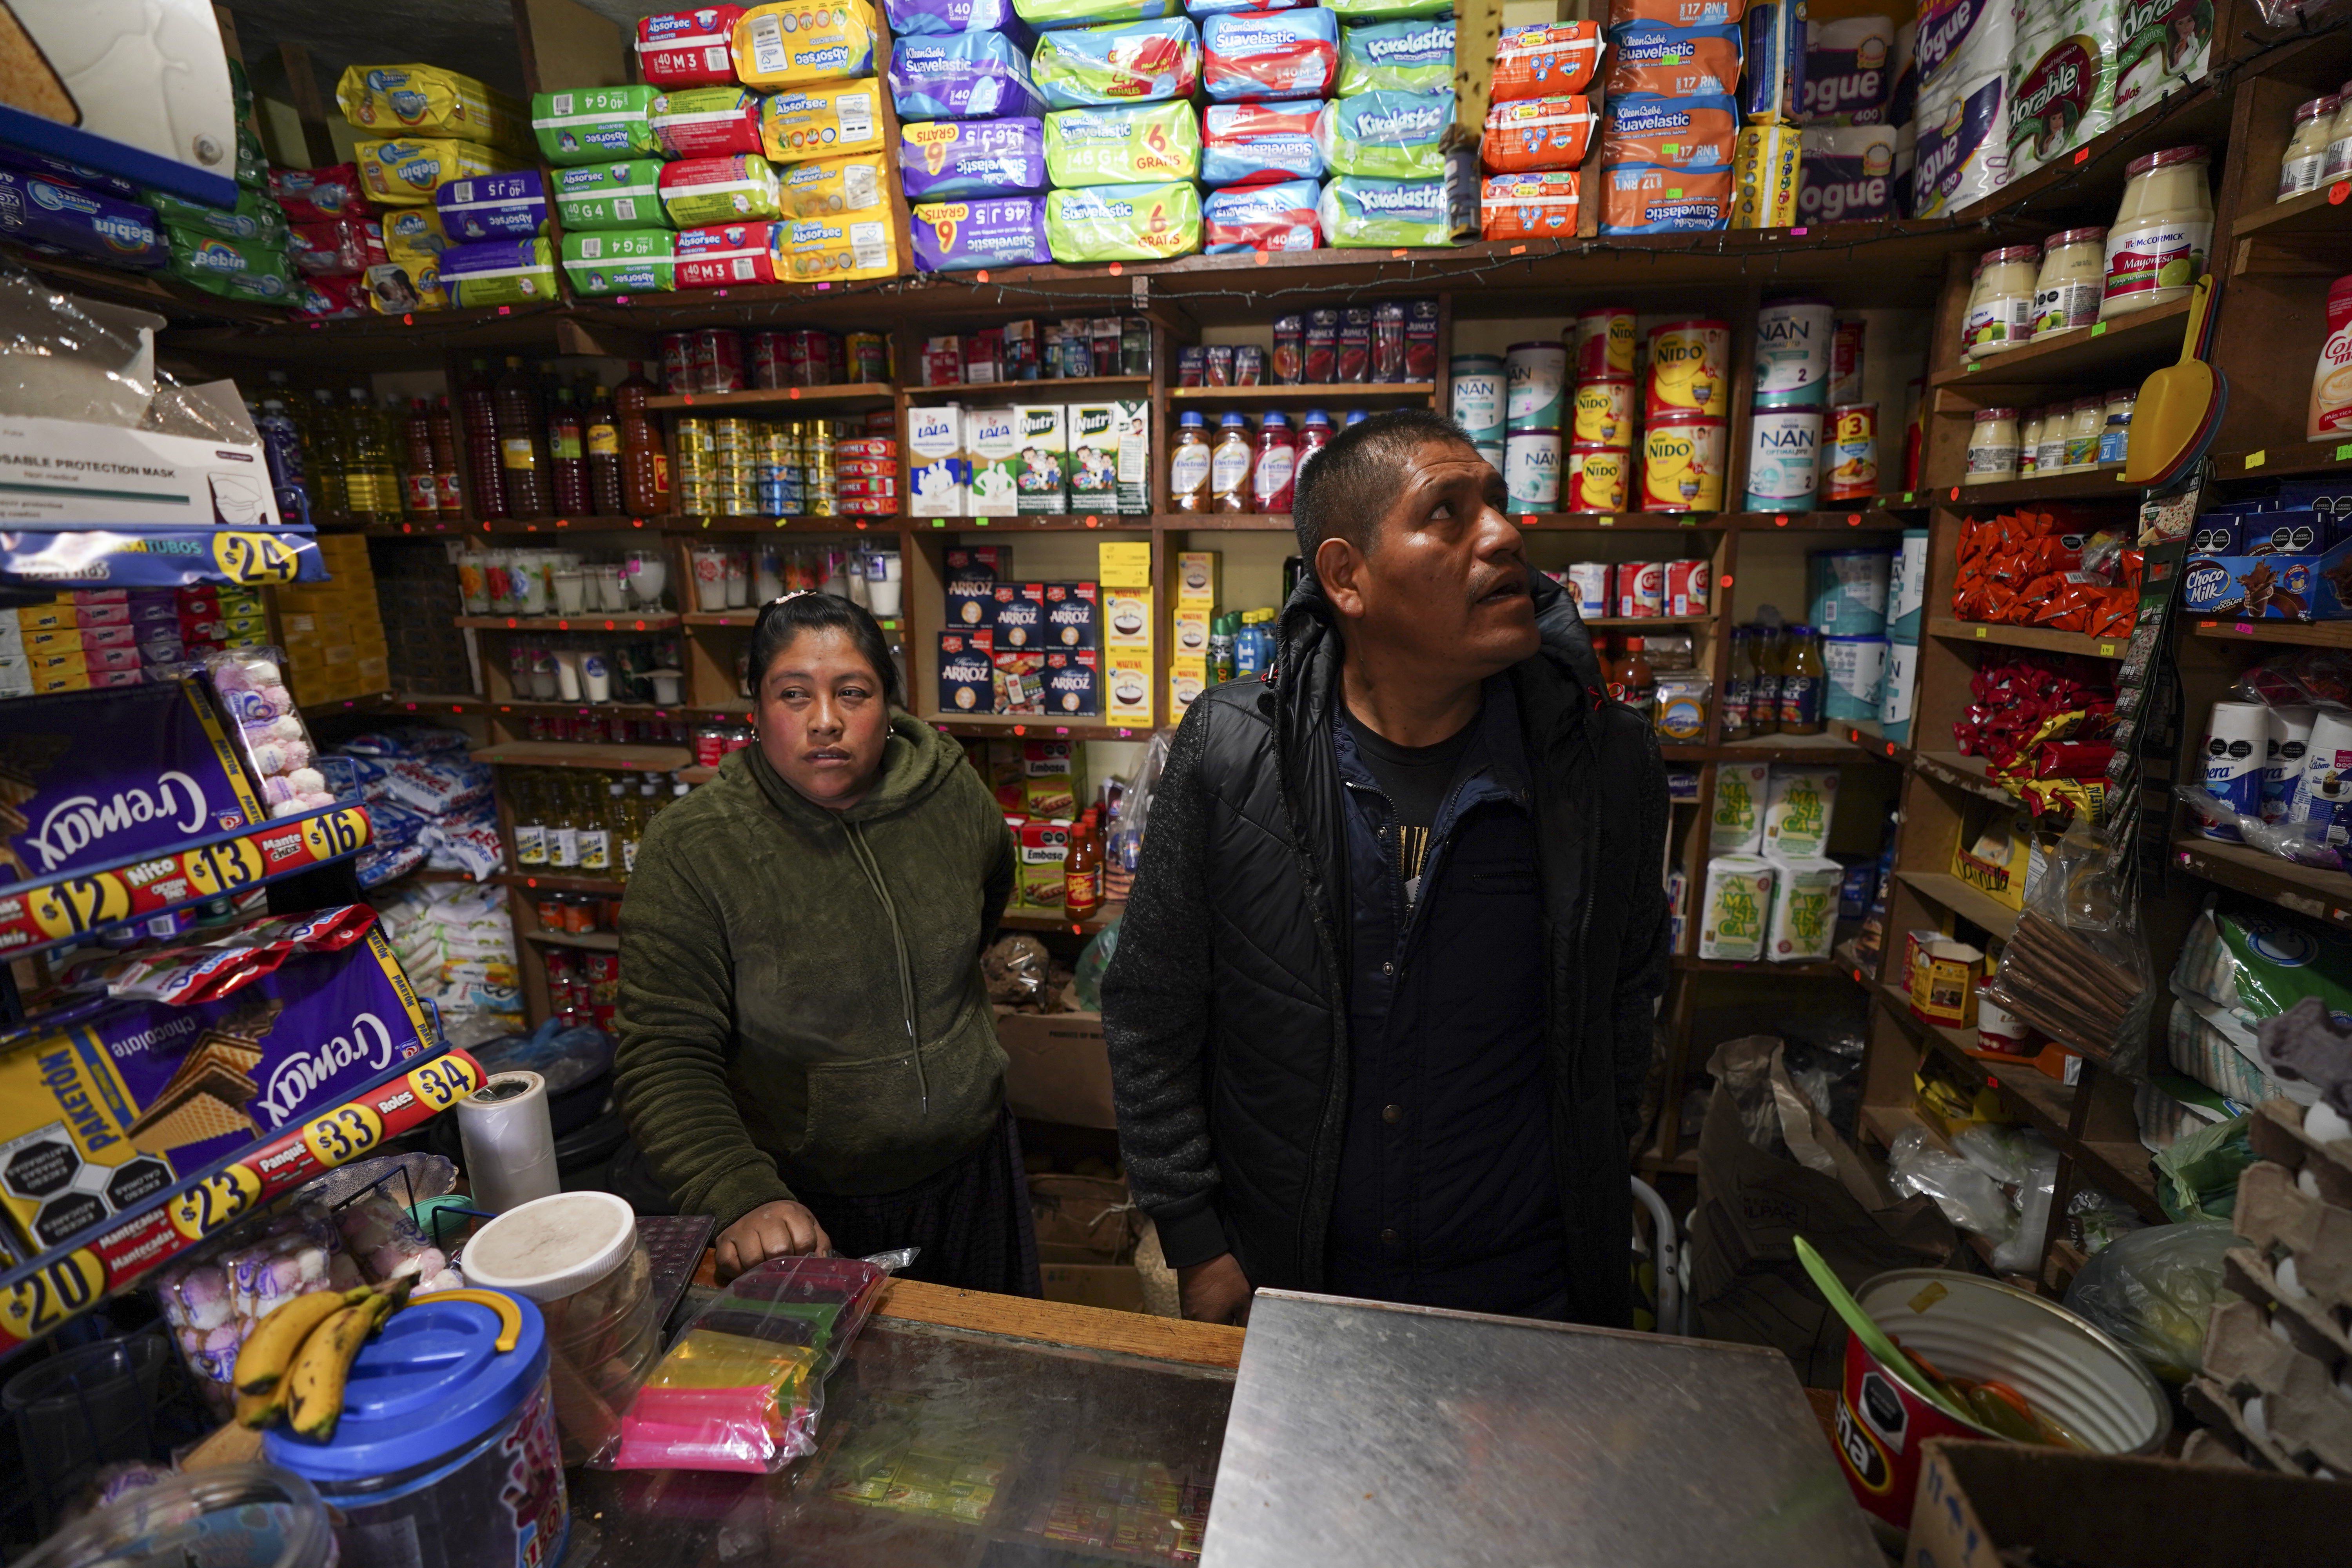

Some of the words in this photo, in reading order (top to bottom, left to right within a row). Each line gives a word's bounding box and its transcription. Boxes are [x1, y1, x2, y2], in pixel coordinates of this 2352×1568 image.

[955, 3, 971, 15] 40
[1687, 3, 1699, 14] 17
[1704, 2, 1719, 14] RN
[648, 19, 691, 34] Absorsec
[1219, 21, 1266, 33] KleenBebé
[1216, 32, 1295, 48] Suavelastic
[1368, 27, 1456, 56] Kikolastic
[1622, 35, 1667, 47] KleenBebé
[795, 46, 849, 65] Absorsec
[906, 47, 946, 59] KleenBebé
[1618, 43, 1694, 60] Suavelastic
[2051, 45, 2078, 67] higiénico
[658, 53, 671, 66] 40
[673, 56, 685, 68] M
[688, 54, 697, 67] 3
[906, 59, 972, 72] Suavelastic
[1684, 76, 1696, 88] 17
[585, 96, 593, 108] 4
[597, 95, 606, 107] G
[775, 100, 827, 115] Absorsec
[1617, 106, 1662, 118] KleenBebé
[1855, 109, 1878, 120] 400
[1060, 122, 1131, 138] Suavelastic
[1613, 114, 1689, 132] Suavelastic
[585, 132, 628, 143] Absorsec
[917, 127, 956, 143] GRATIS
[1148, 124, 1166, 152] 6
[1236, 143, 1312, 156] Suavelastic
[1680, 146, 1692, 157] 17
[956, 158, 1027, 173] Suavelastic
[1137, 155, 1181, 169] GRATIS
[397, 160, 441, 180] Bebin
[788, 170, 836, 185] Absorsec
[563, 173, 604, 184] Absorsec
[1942, 173, 1956, 193] 400
[1799, 177, 1886, 218] ogue
[595, 205, 604, 216] 4
[926, 206, 966, 220] GRATIS
[976, 209, 985, 225] 5
[991, 209, 1000, 223] J
[1004, 209, 1025, 222] 46
[1061, 205, 1132, 220] Suavelastic
[1646, 205, 1719, 219] Suavelastic
[92, 218, 156, 247] Bebin
[792, 228, 842, 243] Absorsec
[2136, 232, 2184, 248] McCORMICK
[612, 241, 620, 253] 4
[624, 241, 633, 252] G
[678, 236, 721, 247] Absorsec
[967, 236, 1035, 250] Suavelastic
[1138, 235, 1180, 247] GRATIS
[194, 249, 248, 271] Bebin
[2124, 254, 2173, 270] Mayonesa
[613, 274, 655, 283] Absorsec
[687, 264, 699, 274] 40
[702, 267, 713, 278] M
[716, 264, 724, 277] 3
[1306, 328, 1334, 339] JUMEX
[1340, 328, 1369, 338] JUMEX
[1406, 321, 1436, 332] JUMEX
[1610, 327, 1635, 339] NIDO
[1657, 345, 1702, 364] NIDO
[1798, 368, 1807, 382] 2
[1457, 383, 1494, 396] NAN
[1578, 398, 1608, 409] NIDO
[1020, 413, 1058, 434] Nutri
[1074, 410, 1114, 433] Nutri
[2325, 412, 2338, 421] ¡Más
[918, 423, 949, 438] LALA
[980, 425, 1010, 439] LALA
[1848, 417, 1862, 435] 3
[1760, 430, 1815, 447] NAN
[1649, 443, 1690, 459] NIDO
[1526, 452, 1558, 466] NAN
[55, 459, 140, 477] PROTECTION
[143, 467, 176, 479] MASK
[1586, 466, 1617, 476] NIDO
[2256, 545, 2271, 554] contigo
[223, 536, 290, 581] $24
[2186, 569, 2225, 590] Choco
[949, 581, 993, 597] ARROZ
[2189, 585, 2221, 603] Milk
[2290, 584, 2307, 593] PANTERA
[2212, 597, 2243, 612] CHOCOLATE
[998, 611, 1037, 625] ARROZ
[1050, 611, 1090, 625] ARROZ
[942, 666, 989, 682] ARROZ
[1051, 676, 1091, 690] ARROZ
[1891, 705, 1895, 718] 1
[214, 739, 240, 776] PAKETÓN
[1030, 762, 1065, 772] Embasa
[2089, 786, 2103, 823] GALLETAS
[25, 771, 208, 871] Cremax
[263, 832, 302, 851] Mante
[309, 812, 356, 856] $16
[1028, 849, 1063, 861] Embasa
[126, 857, 176, 887] Nito
[192, 840, 252, 892] $13
[41, 872, 126, 933] $12
[1724, 893, 1753, 908] MA
[1733, 909, 1758, 923] SE
[1719, 920, 1746, 936] CA
[368, 927, 390, 959] AKETÓN
[392, 975, 416, 1008] PAKETÓN
[111, 1016, 196, 1058] chocolate
[257, 1012, 392, 1127] Cremax
[417, 1059, 470, 1106] $34
[38, 1049, 121, 1152] PAKETÓN
[377, 1091, 414, 1114] Roles
[316, 1109, 374, 1161] $33
[259, 1141, 307, 1173] Panqué
[26, 1167, 68, 1190] EXCESO
[124, 1179, 161, 1202] EXCESO
[180, 1172, 247, 1238] $23
[54, 1213, 94, 1237] EXCESO
[98, 1208, 165, 1250] Mantecadas
[110, 1230, 176, 1272] Mantecadas
[9, 1256, 90, 1334] $20
